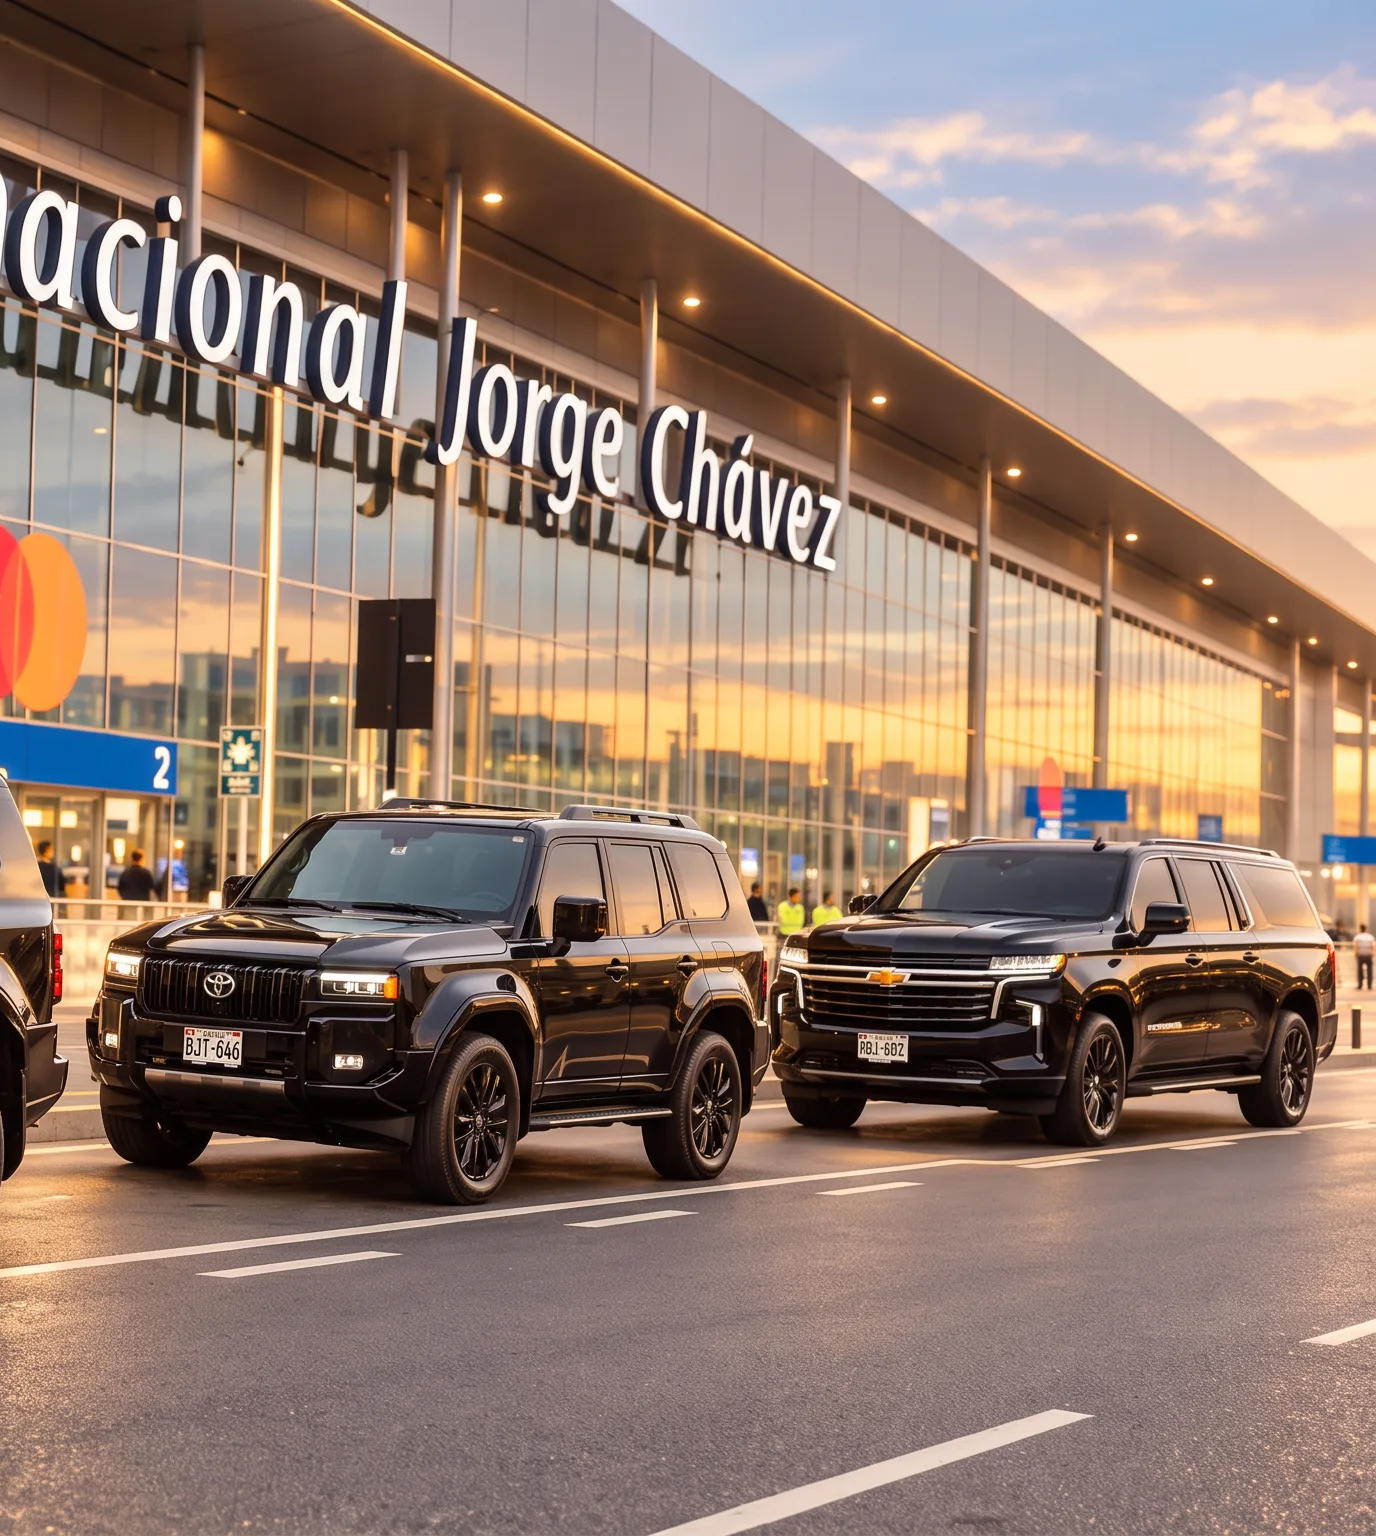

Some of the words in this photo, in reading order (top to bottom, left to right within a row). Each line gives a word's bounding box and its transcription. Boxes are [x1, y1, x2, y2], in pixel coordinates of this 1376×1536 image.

[426, 317, 623, 515] Jorge
[642, 405, 842, 572] Chávez
[153, 745, 171, 790] 2
[185, 1037, 240, 1060] BJT-646
